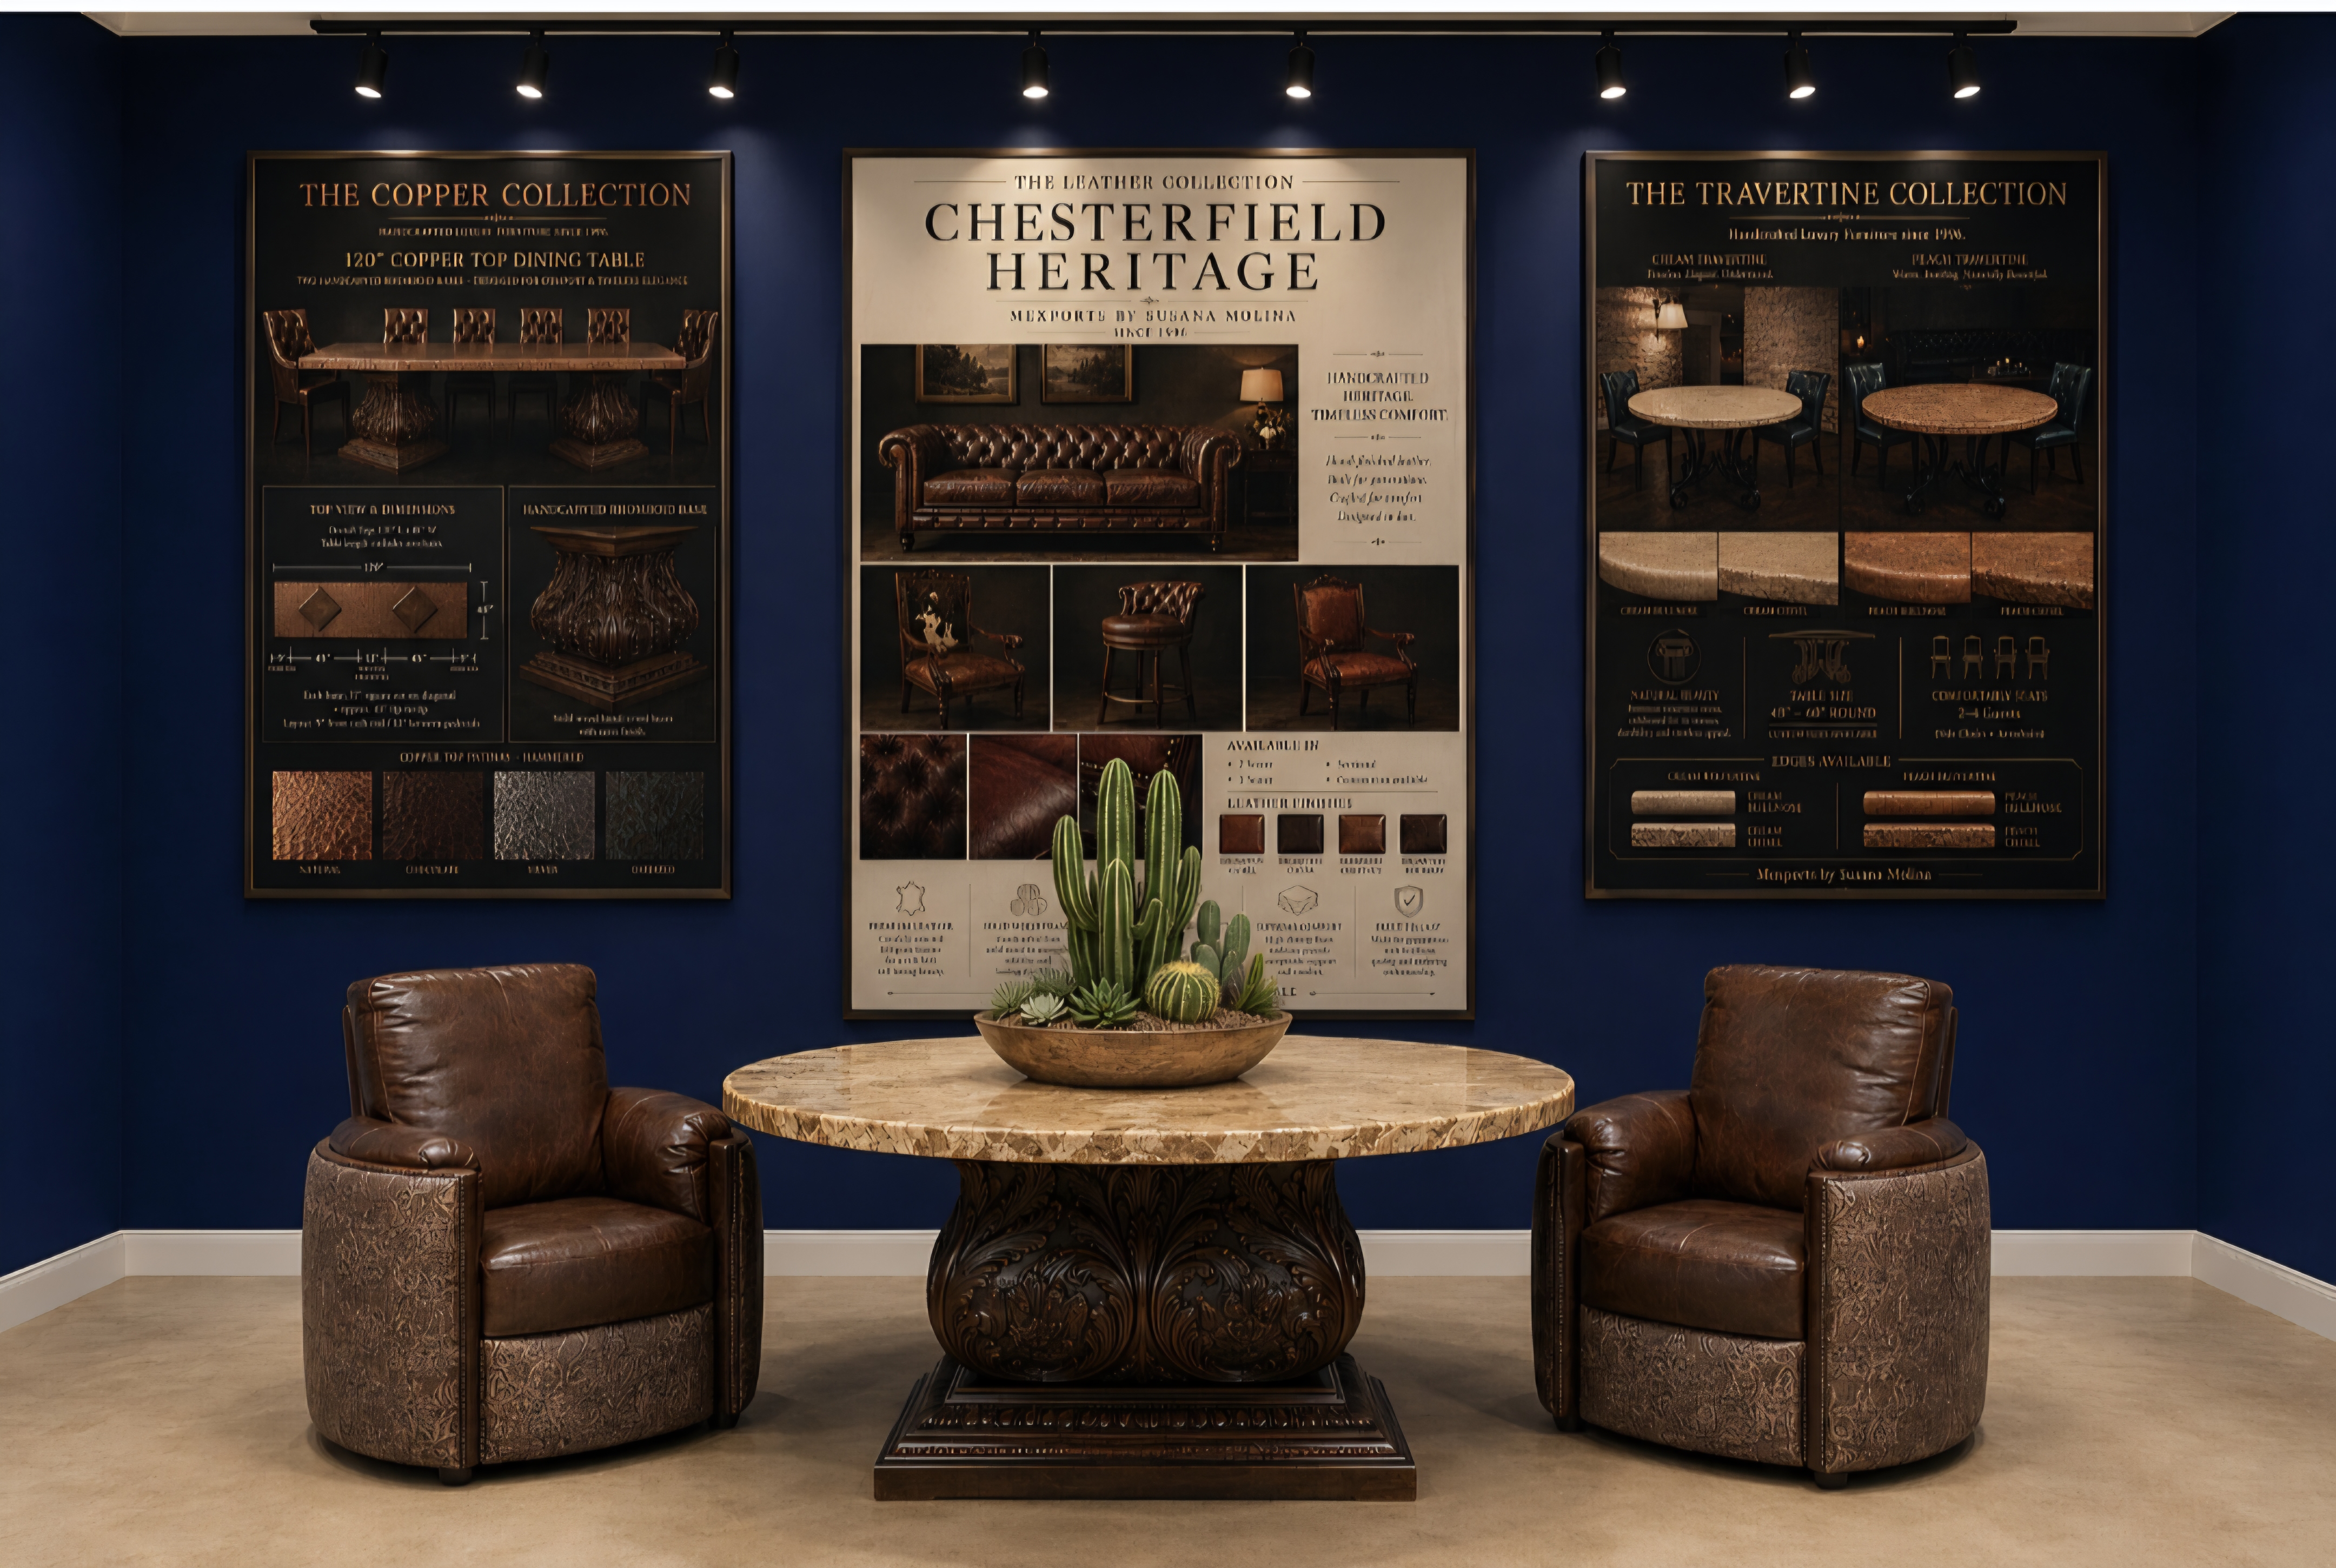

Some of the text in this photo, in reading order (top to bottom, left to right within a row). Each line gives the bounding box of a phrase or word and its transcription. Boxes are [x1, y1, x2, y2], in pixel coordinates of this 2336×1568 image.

[1015, 175, 1293, 190] THE LEATHER COLLECTION
[1627, 182, 2066, 205] THE TRAVERTINE COLLECTION
[300, 183, 689, 206] THE COPPER COLLECTION
[926, 202, 1385, 241] CHESTERFIELD
[347, 253, 643, 267] 120" COPPER TOP DINING TABLE
[987, 253, 1317, 290] HERITAGE
